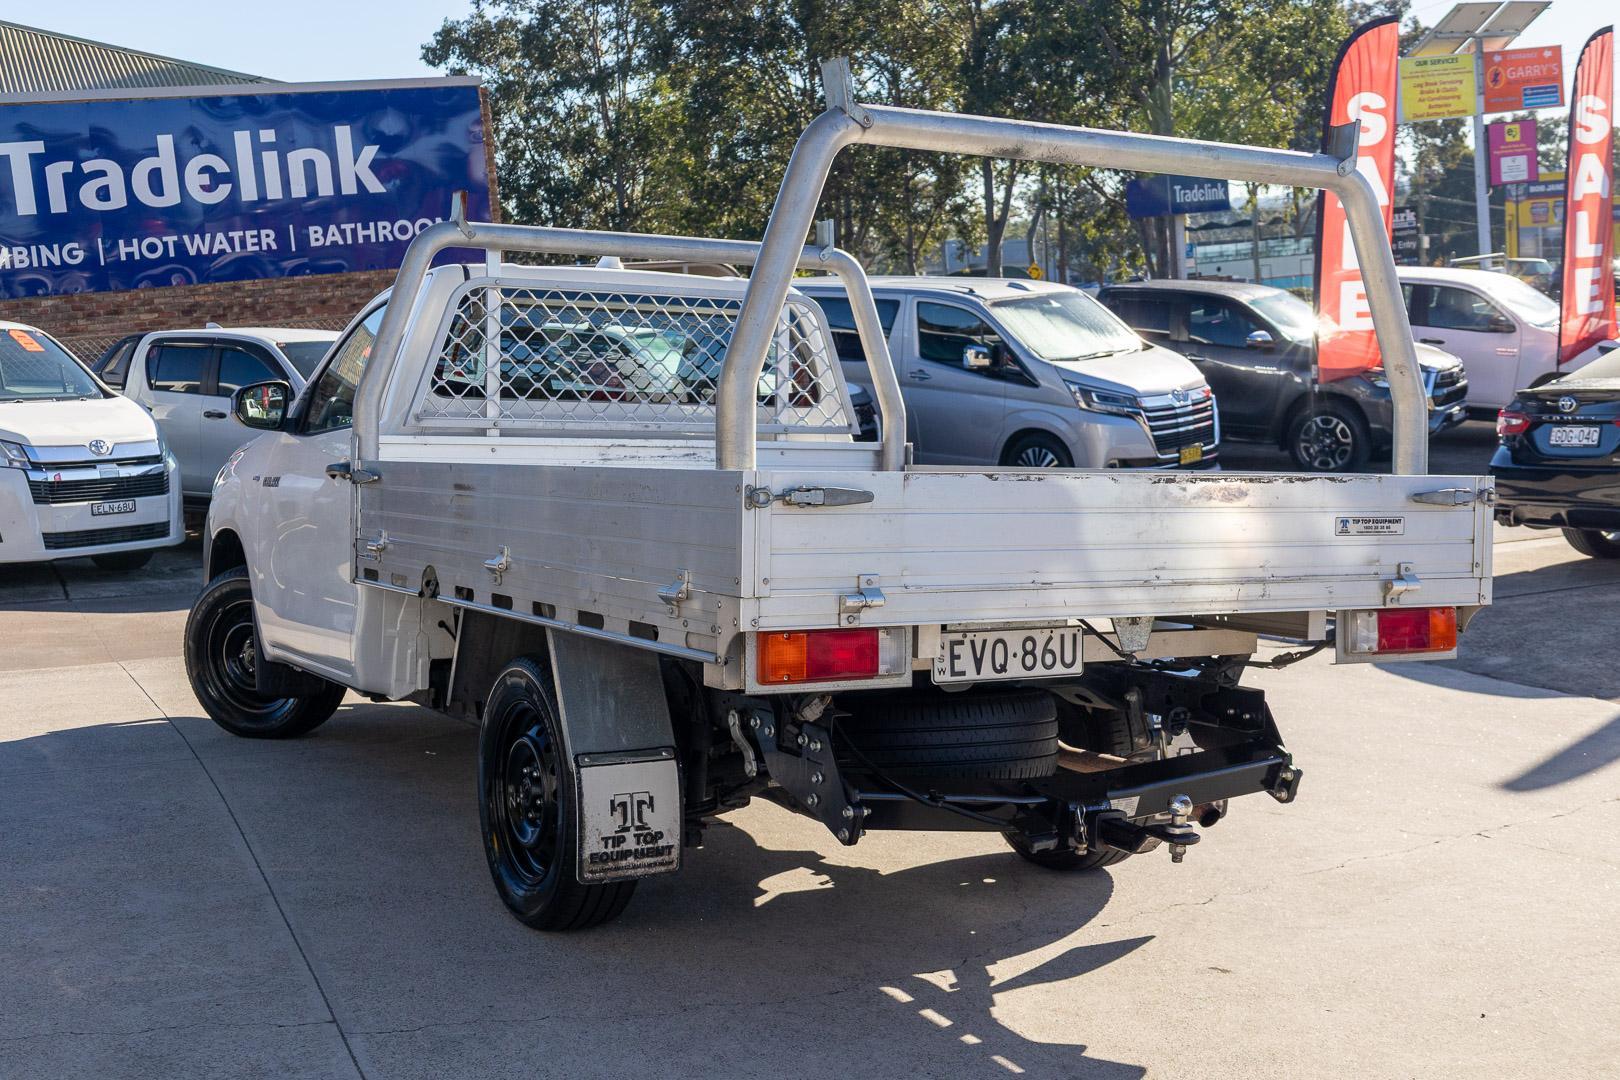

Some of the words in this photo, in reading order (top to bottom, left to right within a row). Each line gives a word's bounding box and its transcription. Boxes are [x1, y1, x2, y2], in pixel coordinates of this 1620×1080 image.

[1430, 57, 1459, 66] SERVICES
[1506, 63, 1559, 79] GARRY'S
[0, 125, 388, 217] Tradelink
[1173, 182, 1226, 203] Tradelink
[1574, 94, 1610, 316] SALE
[118, 235, 178, 261] HOT
[182, 229, 277, 255] WATER
[308, 217, 453, 248] BATHROO
[600, 835, 626, 850] TIP
[633, 830, 664, 846] TOP
[589, 844, 675, 865] EQUIPMENT
